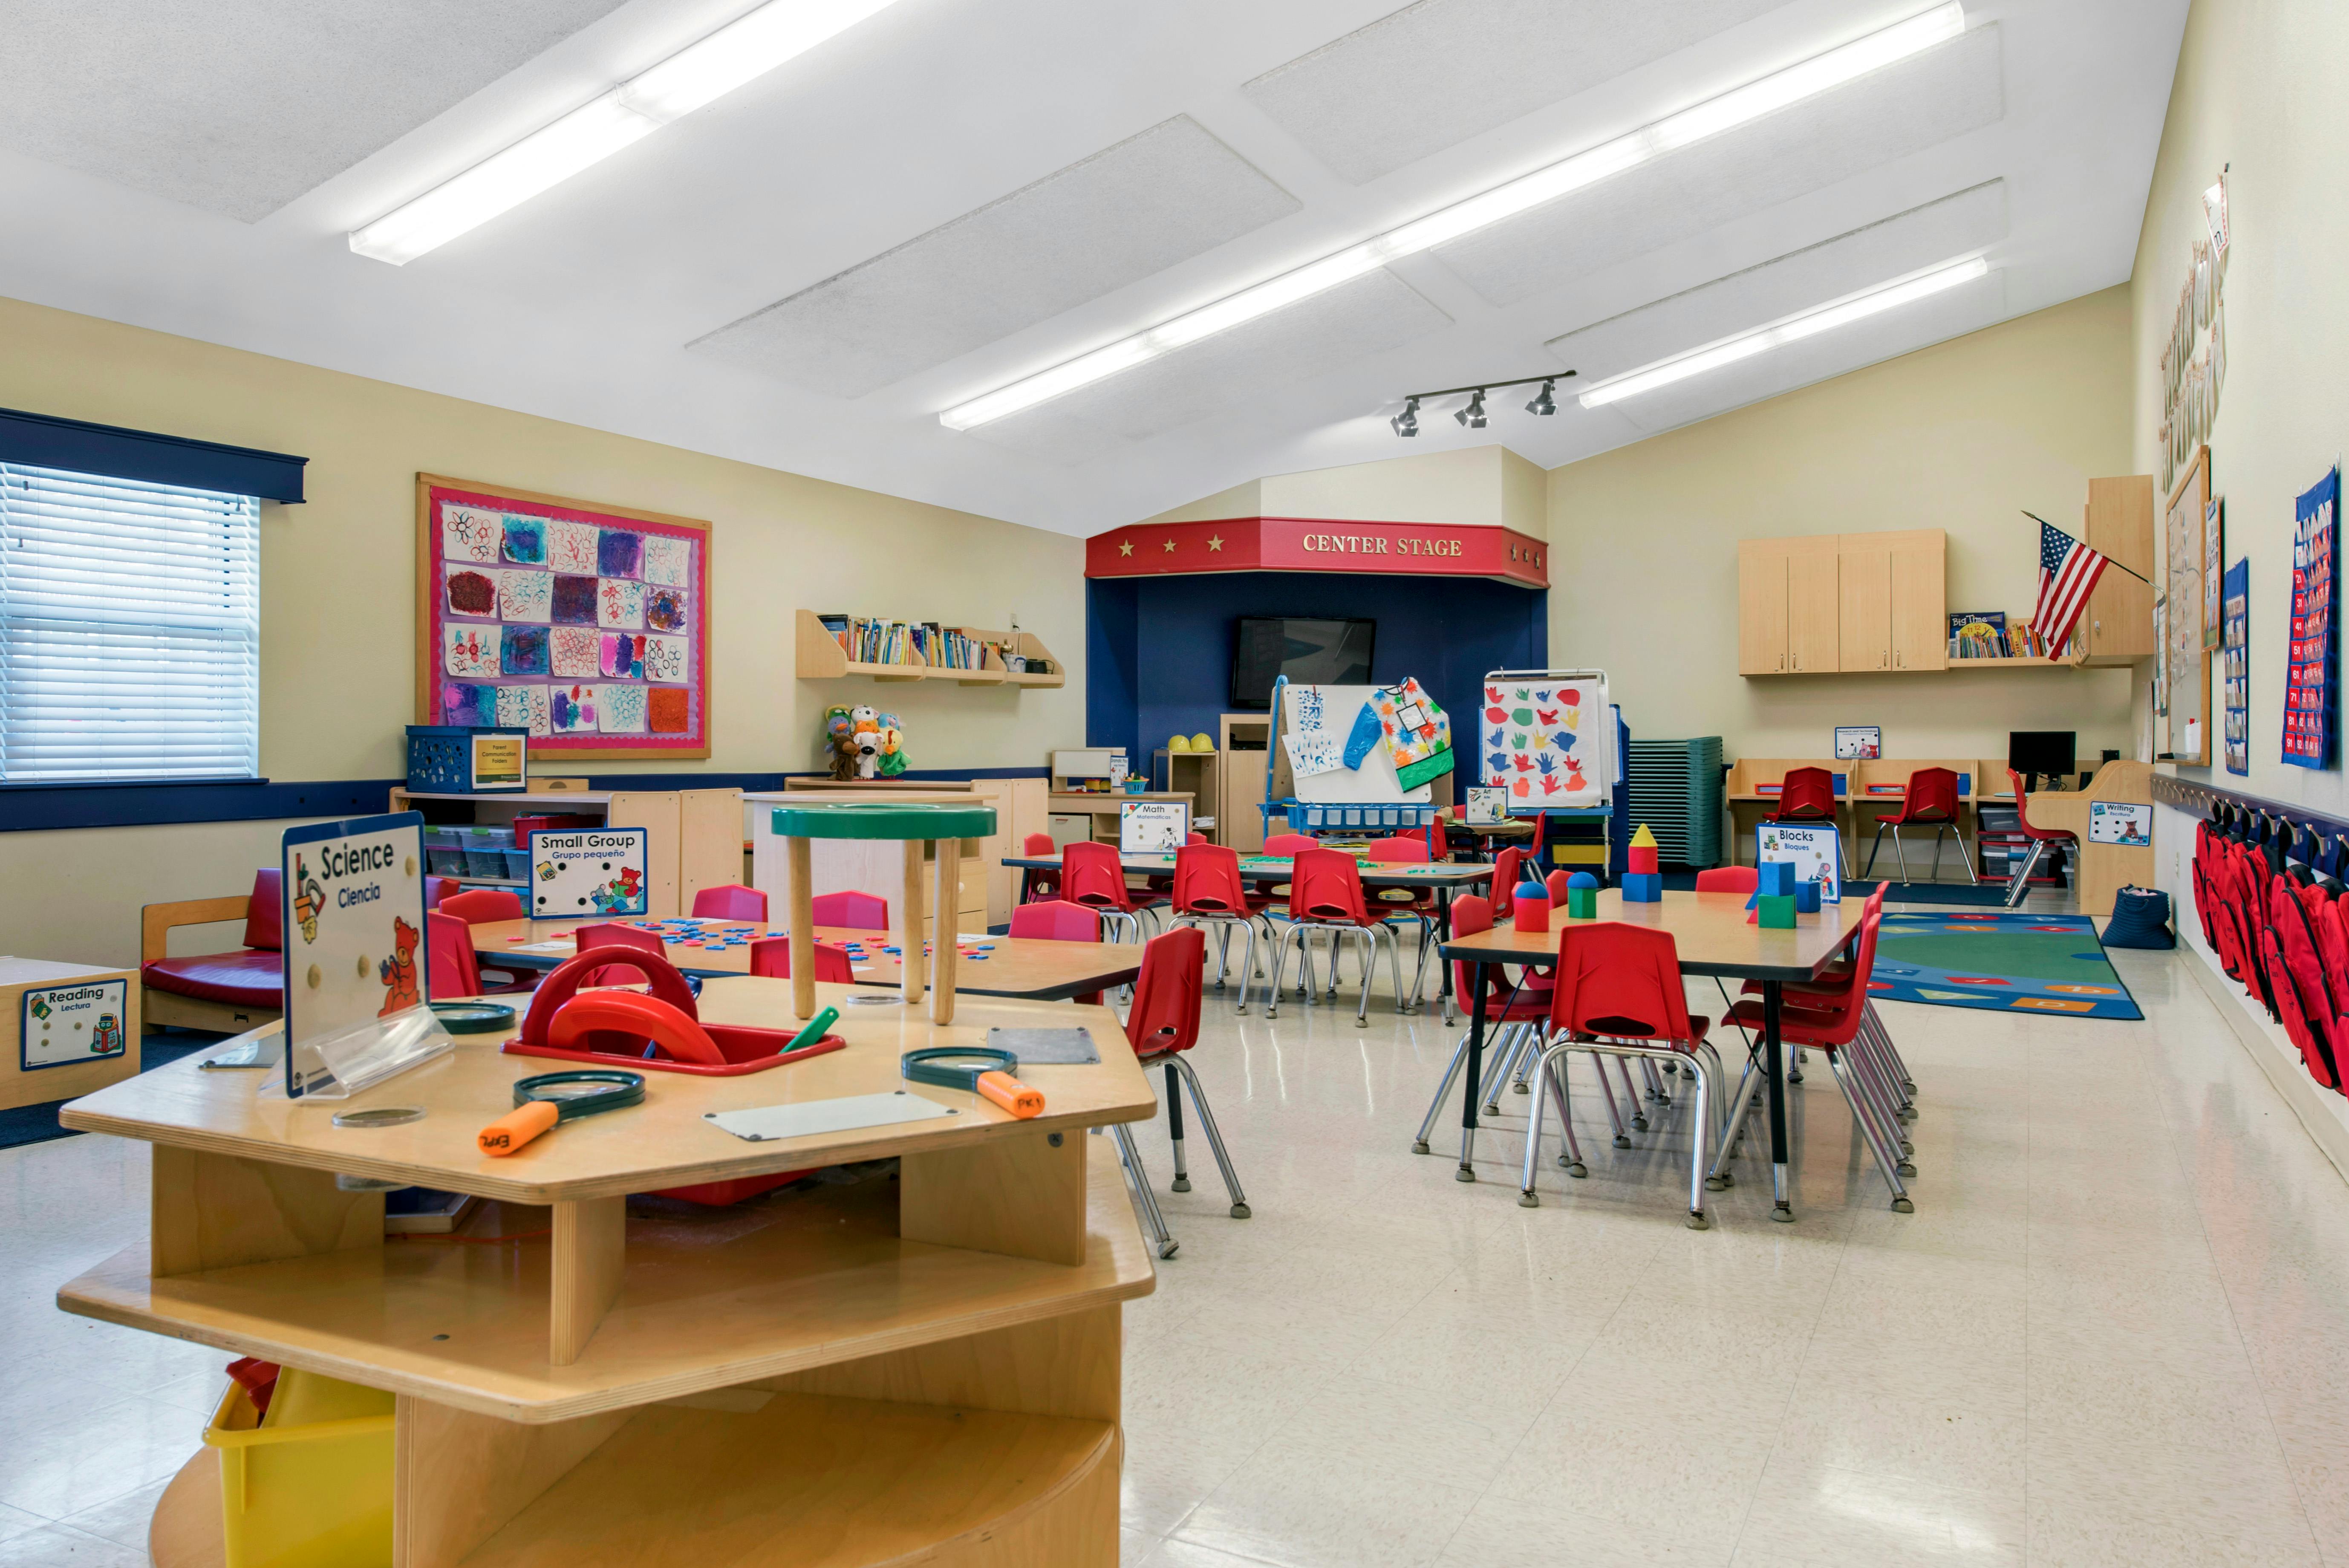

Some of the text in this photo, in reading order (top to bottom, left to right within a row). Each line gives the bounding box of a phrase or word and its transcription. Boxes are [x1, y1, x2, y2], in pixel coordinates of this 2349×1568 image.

[1303, 534, 1462, 557] CENTER STAGE
[2296, 575, 2302, 584] 21
[2297, 598, 2303, 607] 31
[1952, 618, 1967, 626] Big
[1965, 615, 1988, 624] Time
[2295, 622, 2302, 631] 41
[2294, 645, 2300, 655] 51
[2293, 670, 2299, 679] 61
[2291, 692, 2297, 702] 71
[2288, 716, 2294, 725] 81
[2299, 717, 2304, 727] 82
[2287, 738, 2292, 748] 91
[2297, 739, 2303, 749] 92
[2107, 804, 2135, 813] Writing
[1780, 829, 1814, 842] Blocks
[541, 835, 635, 849] Small Group
[1784, 843, 1809, 852] Bloques
[552, 849, 625, 860] Grupo pequeño
[321, 842, 394, 881] Science
[338, 881, 381, 908] Ciencia
[49, 988, 104, 1003] Reading
[61, 1003, 91, 1012] Lectura
